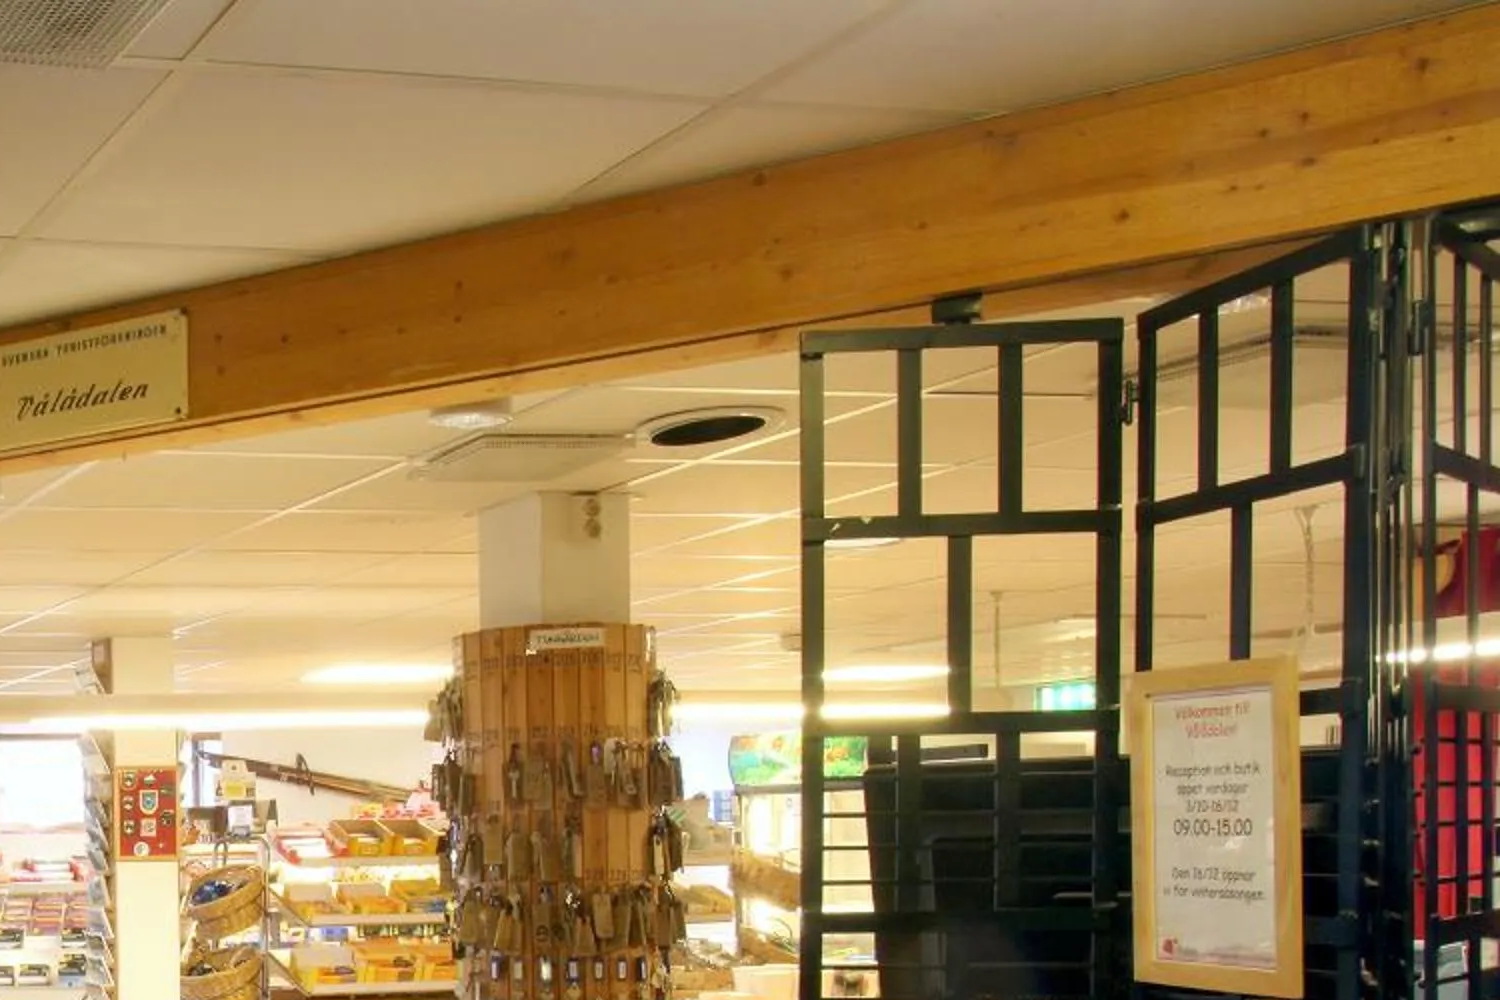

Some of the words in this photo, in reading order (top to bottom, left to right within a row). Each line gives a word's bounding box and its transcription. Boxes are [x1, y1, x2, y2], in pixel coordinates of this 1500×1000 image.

[1, 349, 49, 368] SVENSKA
[1165, 764, 1211, 779] Reception
[1233, 760, 1260, 775] butik
[1173, 818, 1253, 836] 09.00-15.00
